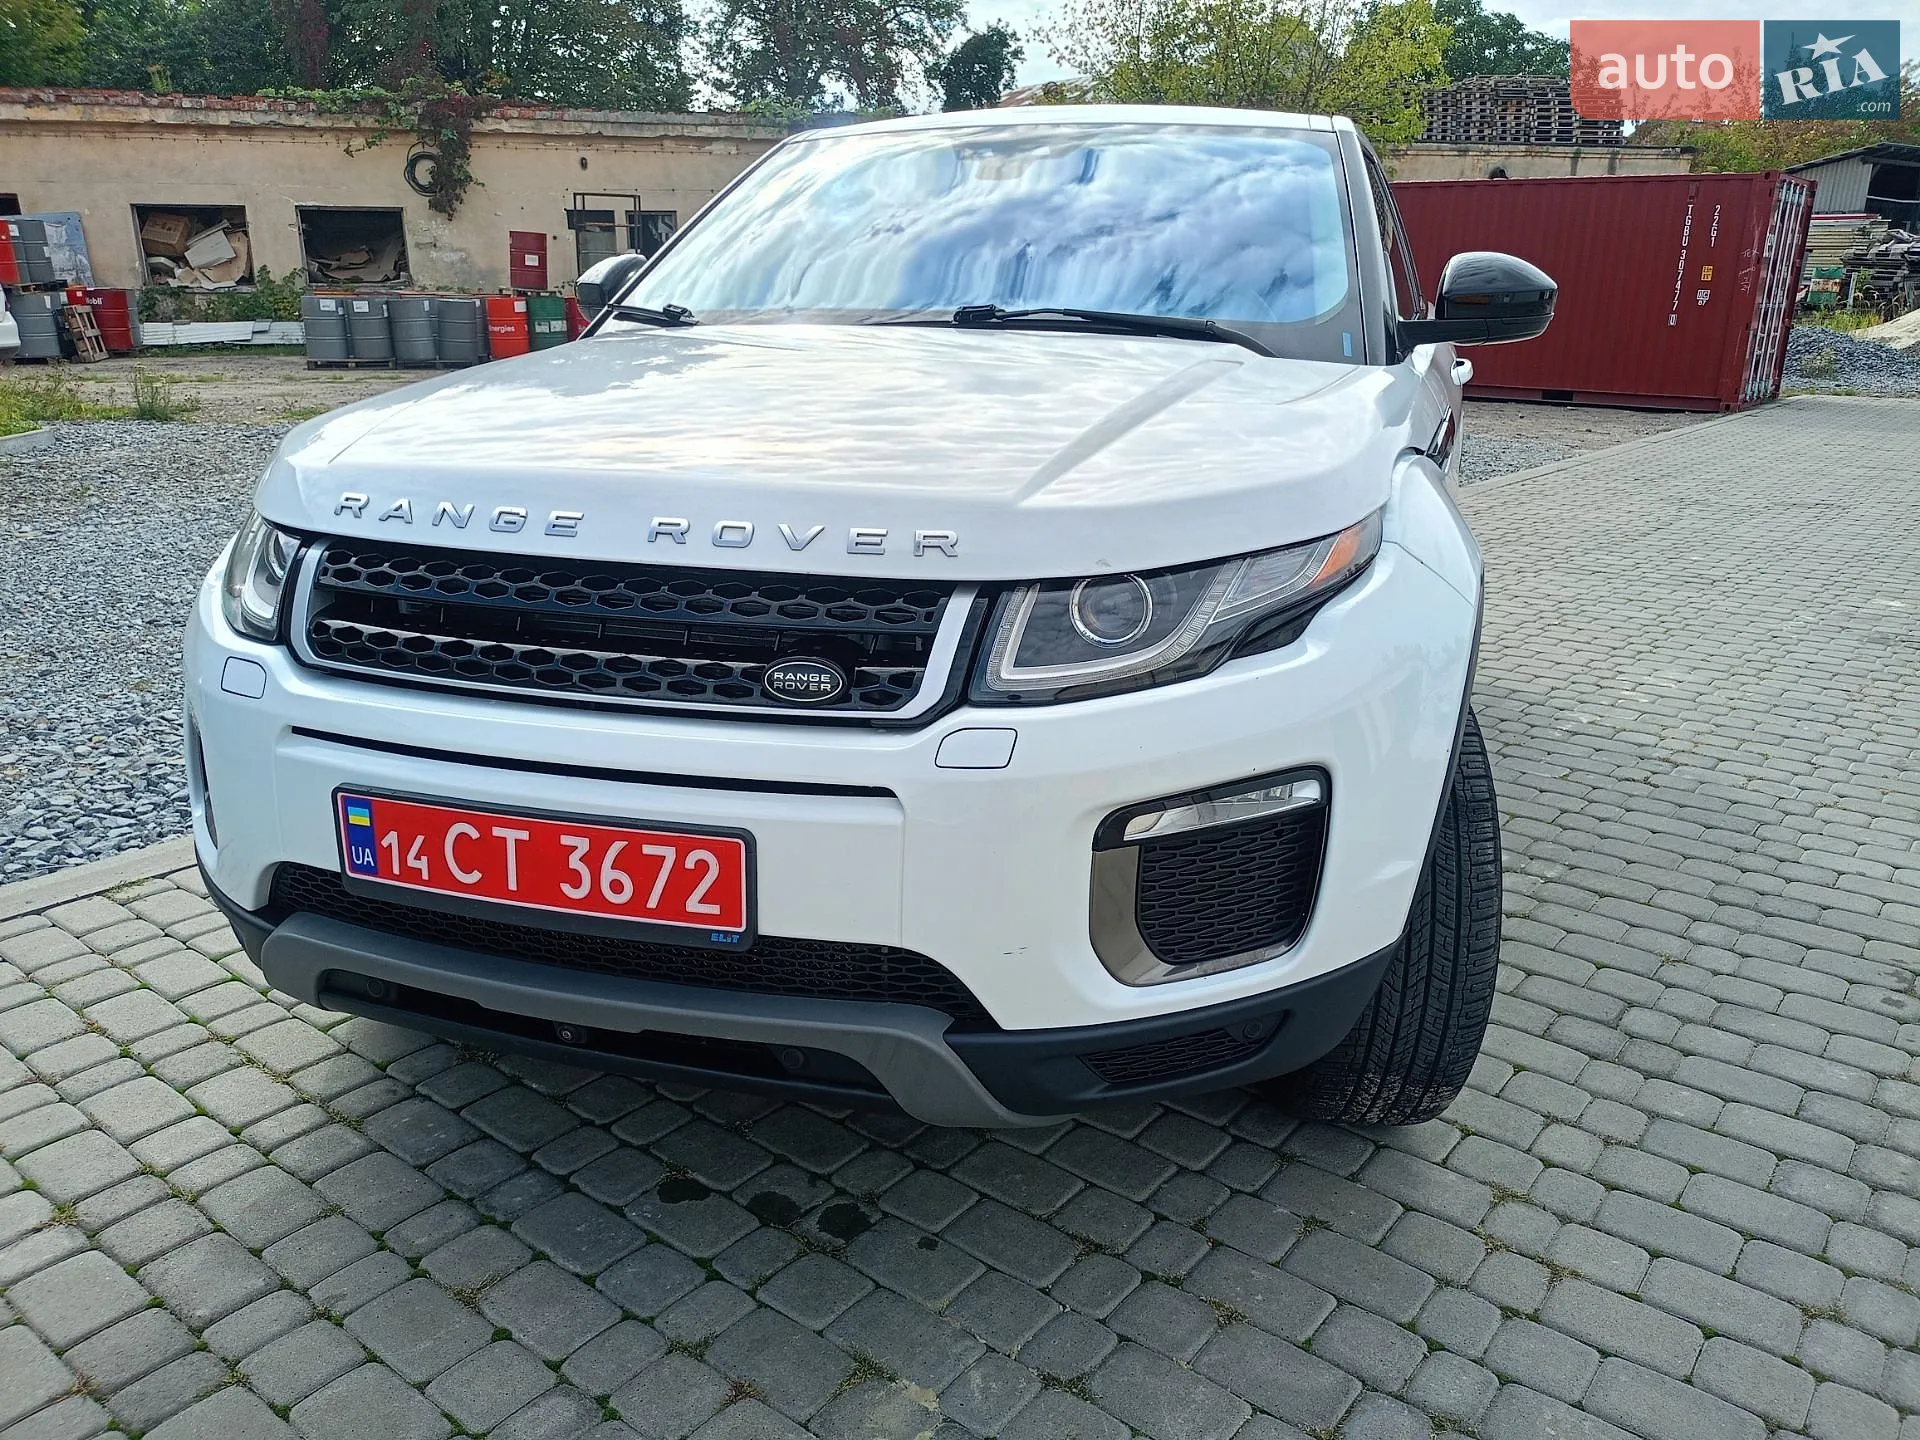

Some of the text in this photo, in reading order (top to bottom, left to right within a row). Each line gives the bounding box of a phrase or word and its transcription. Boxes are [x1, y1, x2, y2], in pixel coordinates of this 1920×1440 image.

[1681, 204, 1694, 247] TGBU
[1710, 204, 1721, 248] 22G1
[1672, 249, 1687, 311] 307477
[334, 491, 959, 558] RANGE ROVER
[773, 672, 831, 682] RANGE
[773, 681, 832, 692] ROVER
[351, 845, 375, 867] UA
[381, 822, 721, 915] 14 CT 3672
